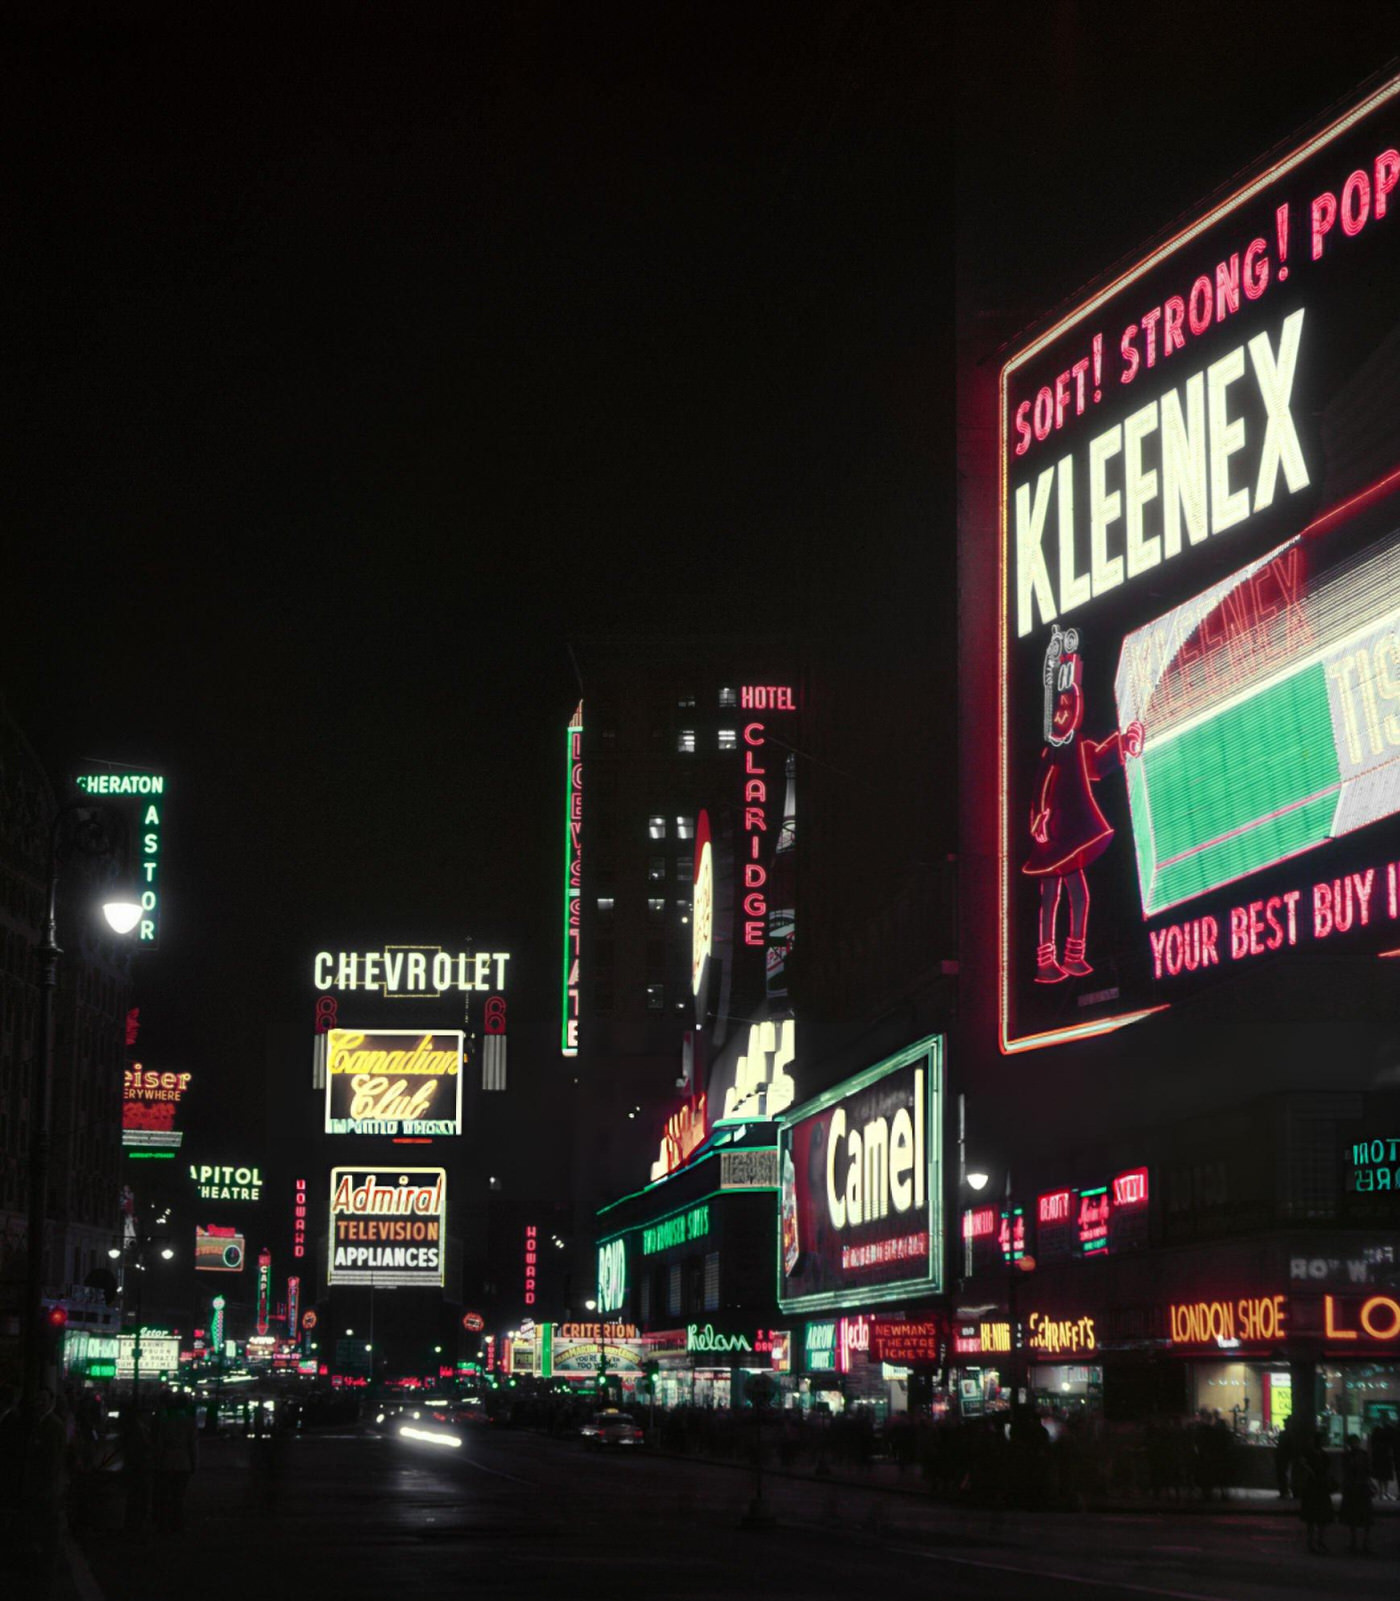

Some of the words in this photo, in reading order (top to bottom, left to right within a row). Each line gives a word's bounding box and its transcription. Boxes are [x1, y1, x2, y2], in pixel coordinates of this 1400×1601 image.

[1015, 332, 1103, 455] SOFT!
[1119, 202, 1289, 384] STRONG!
[1312, 148, 1400, 262] POP
[1015, 306, 1310, 638] KLEENEX
[741, 686, 796, 711] HOTEL
[743, 723, 767, 946] CLARIDGE
[140, 804, 159, 941] ASTOR
[1150, 915, 1219, 979] YOUR
[1230, 890, 1300, 961] BEST
[1313, 868, 1375, 939] BUY
[314, 951, 511, 991] CHEVROLET
[329, 1029, 460, 1075] Canadian
[350, 1073, 438, 1120] Club
[826, 1068, 925, 1231] Camel
[197, 1185, 260, 1200] HEATRE
[332, 1174, 443, 1215] Admiral
[337, 1220, 439, 1241] TELEVISION
[334, 1246, 439, 1268] APPLIANCES
[525, 1226, 537, 1305] HOWARD
[562, 1323, 636, 1339] CRITERION
[807, 1323, 835, 1350] ARROW
[875, 1323, 936, 1336] NEWMAN'S
[1170, 1301, 1235, 1343] LONDON
[1238, 1294, 1286, 1340] SHOE
[1323, 1294, 1400, 1340] LO
[876, 1338, 936, 1349] THEATRE
[879, 1347, 936, 1359] TICKETS
